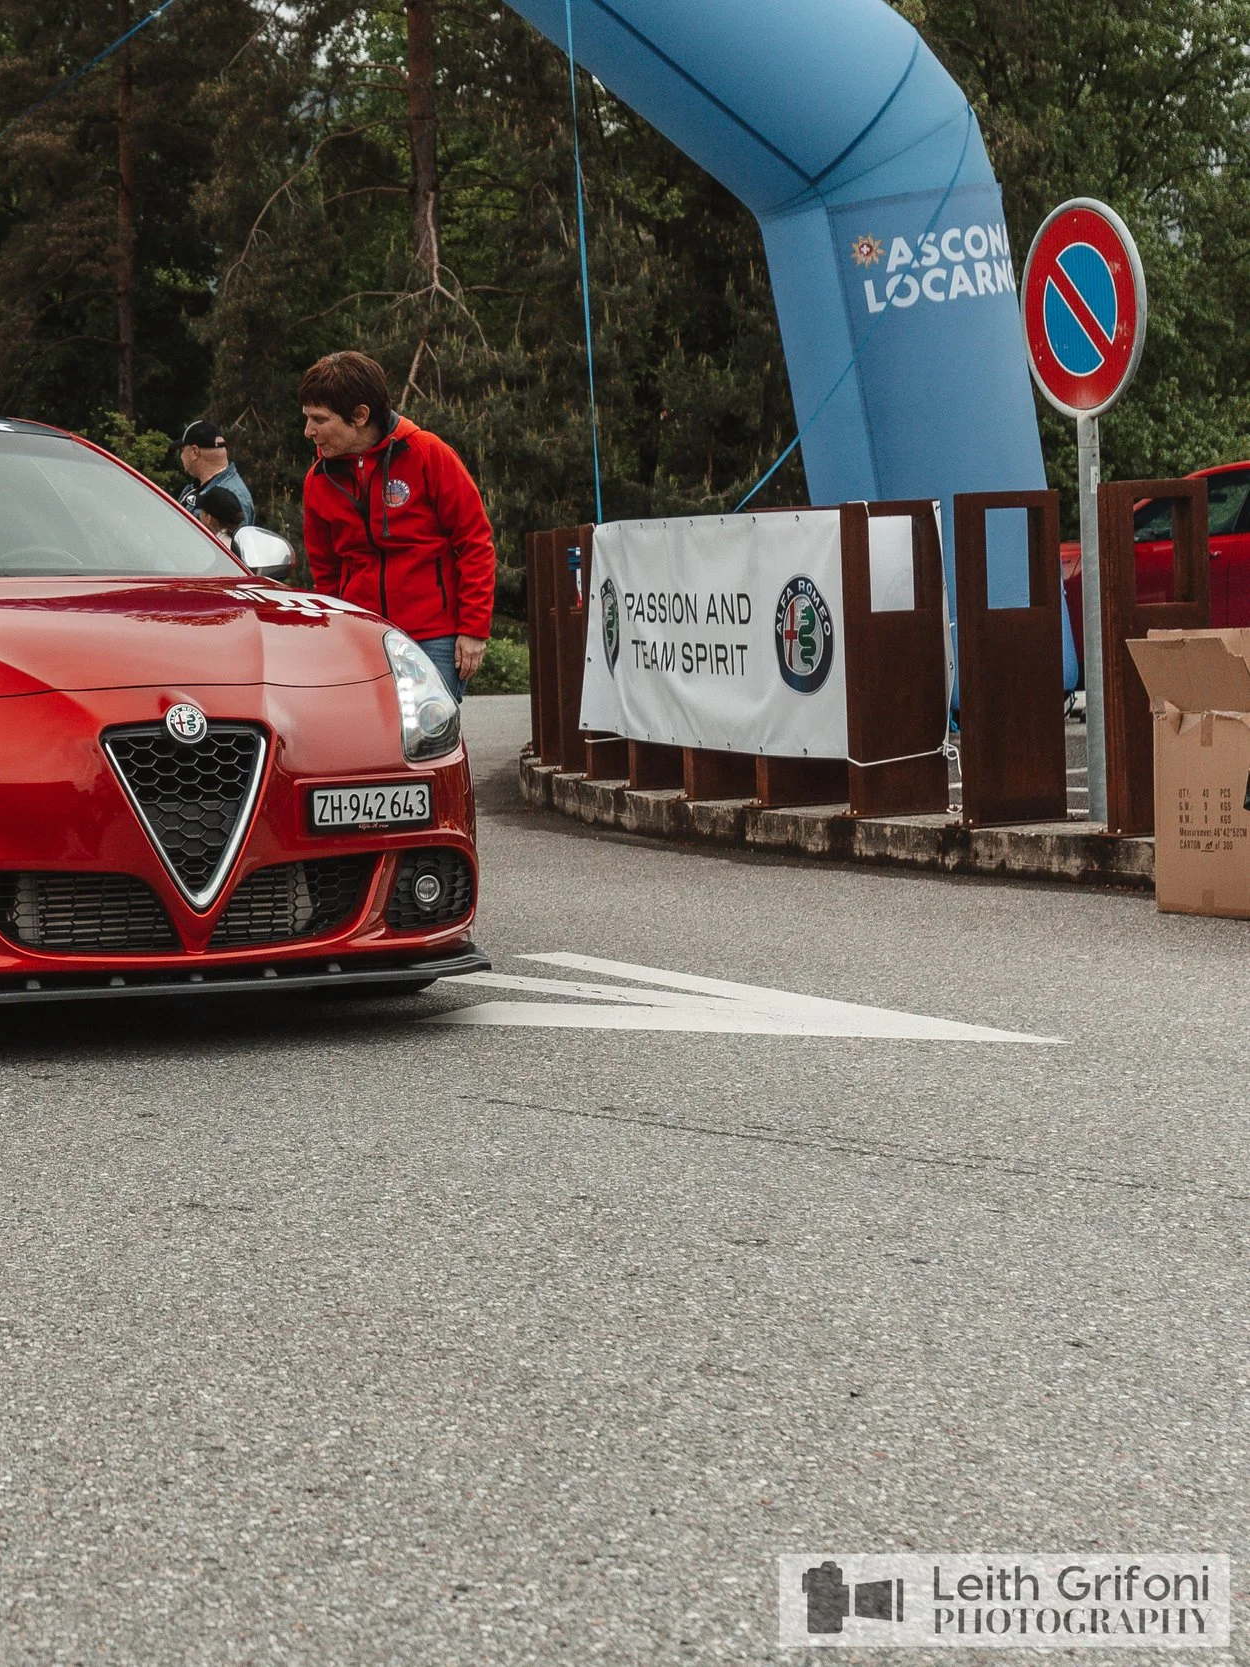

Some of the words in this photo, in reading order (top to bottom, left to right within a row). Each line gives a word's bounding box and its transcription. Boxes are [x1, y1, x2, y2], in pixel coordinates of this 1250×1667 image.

[624, 592, 698, 624] PASSION
[705, 592, 751, 625] AND
[776, 587, 794, 636] ALFA
[797, 579, 831, 637] ROMEO
[631, 639, 676, 672] TEAM
[681, 641, 748, 677] SPIRIT
